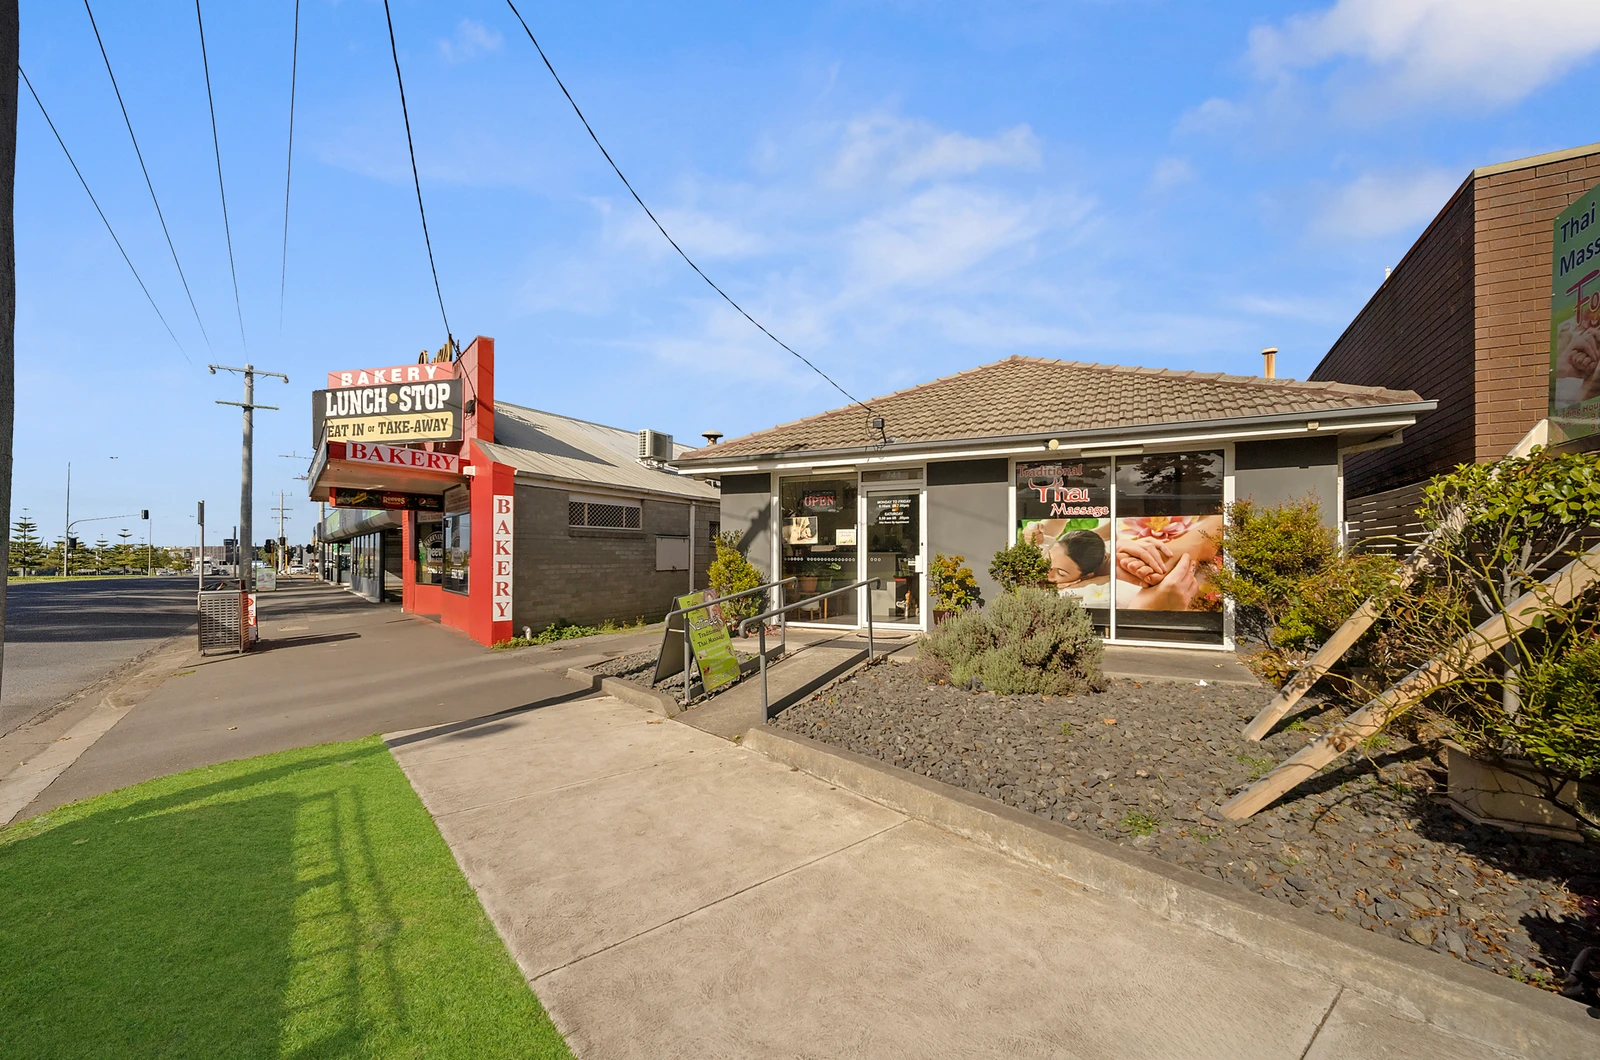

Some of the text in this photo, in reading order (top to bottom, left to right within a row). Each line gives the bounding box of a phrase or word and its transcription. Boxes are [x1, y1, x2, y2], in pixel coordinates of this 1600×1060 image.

[1561, 201, 1595, 244] Thai
[340, 365, 438, 386] BAKERY
[325, 383, 451, 416] LUNCH STOP
[1583, 403, 1600, 412] Hou
[327, 424, 349, 437] EAT
[352, 423, 365, 436] IN
[378, 418, 449, 434] TAKE-AWAY
[350, 442, 456, 470] BAKERY
[1016, 464, 1083, 477] Traditional
[1027, 477, 1091, 503] Thai
[803, 496, 835, 507] OPEN
[1050, 503, 1110, 517] Massage
[495, 499, 512, 618] BAKERY
